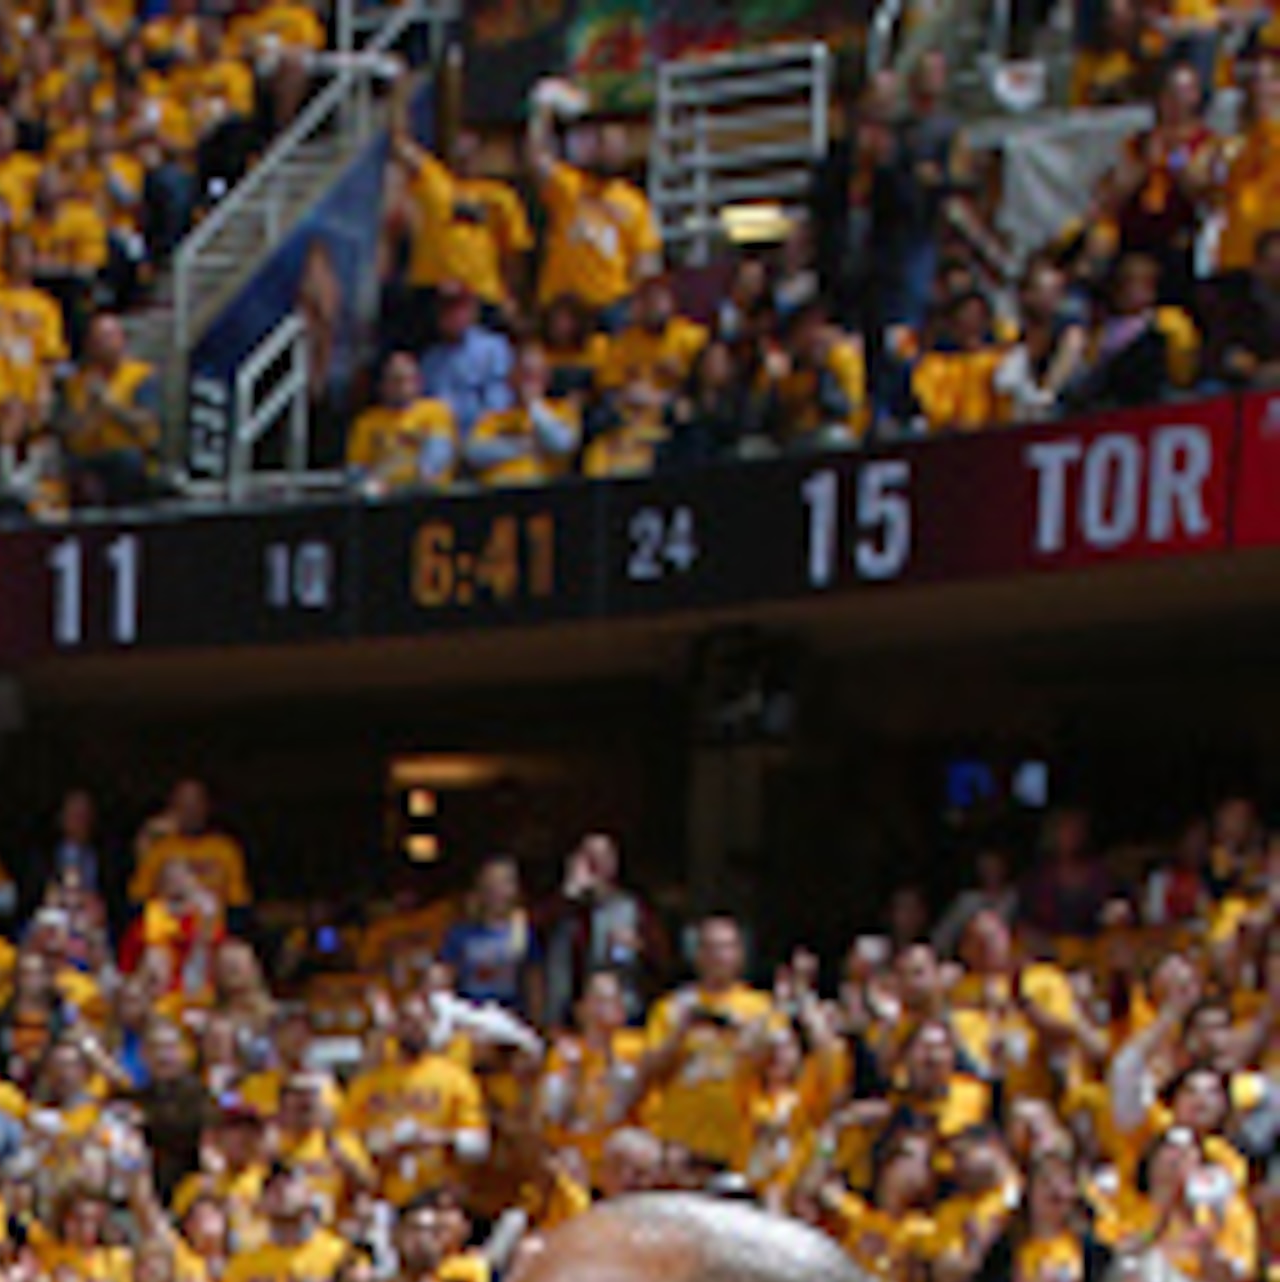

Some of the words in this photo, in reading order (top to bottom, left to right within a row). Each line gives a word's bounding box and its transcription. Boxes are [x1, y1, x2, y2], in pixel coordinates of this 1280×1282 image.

[49, 531, 139, 646] 11
[412, 511, 556, 608] 6:41
[626, 505, 697, 581] 24
[800, 459, 912, 589] 15
[1024, 422, 1215, 555] TOR
